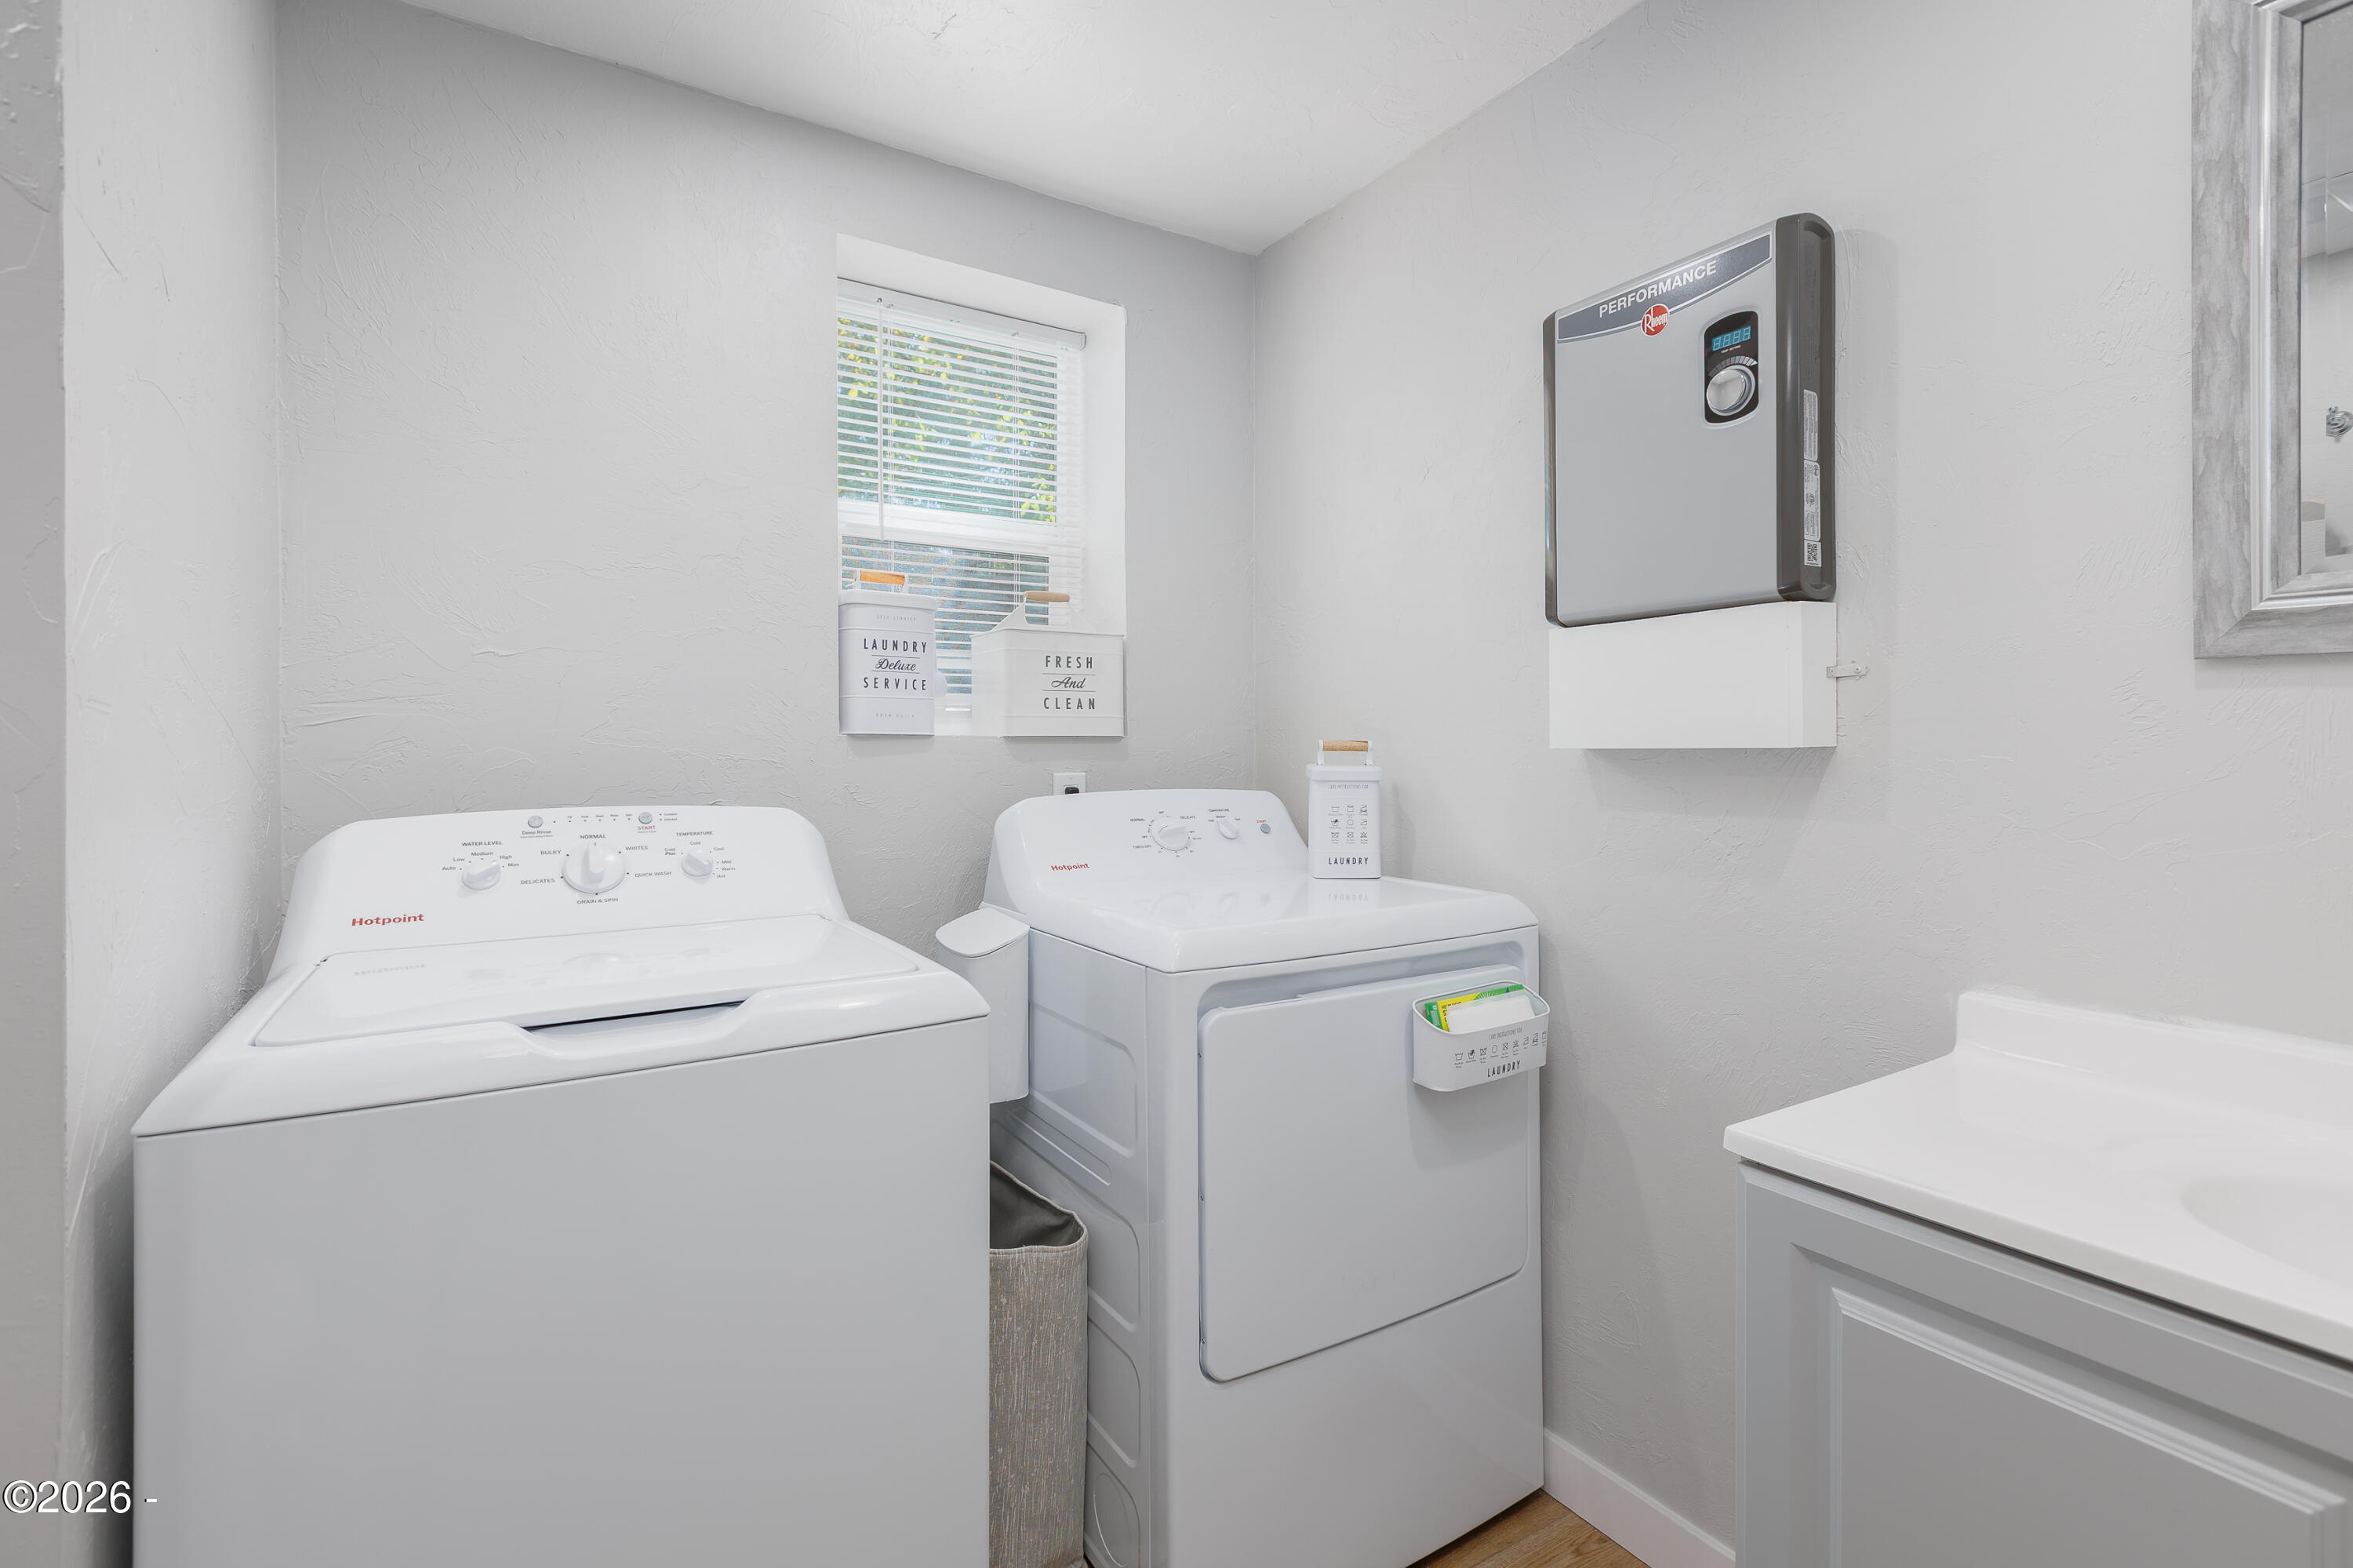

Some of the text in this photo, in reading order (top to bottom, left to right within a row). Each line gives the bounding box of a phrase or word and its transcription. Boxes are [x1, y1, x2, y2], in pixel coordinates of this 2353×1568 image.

[1599, 260, 1717, 318] PERFORMANCE
[1644, 306, 1668, 333] Rheem
[864, 638, 926, 653] LAUNDRY
[875, 658, 917, 671] Deluxe
[1045, 655, 1093, 669] FRESH
[864, 677, 926, 691] SERVICE
[1051, 676, 1086, 689] And
[1043, 697, 1096, 710] CLEAN
[1050, 863, 1089, 872] Hotpoint
[351, 914, 424, 926] Hotpoint
[1487, 1060, 1521, 1077] LAUNDRY
